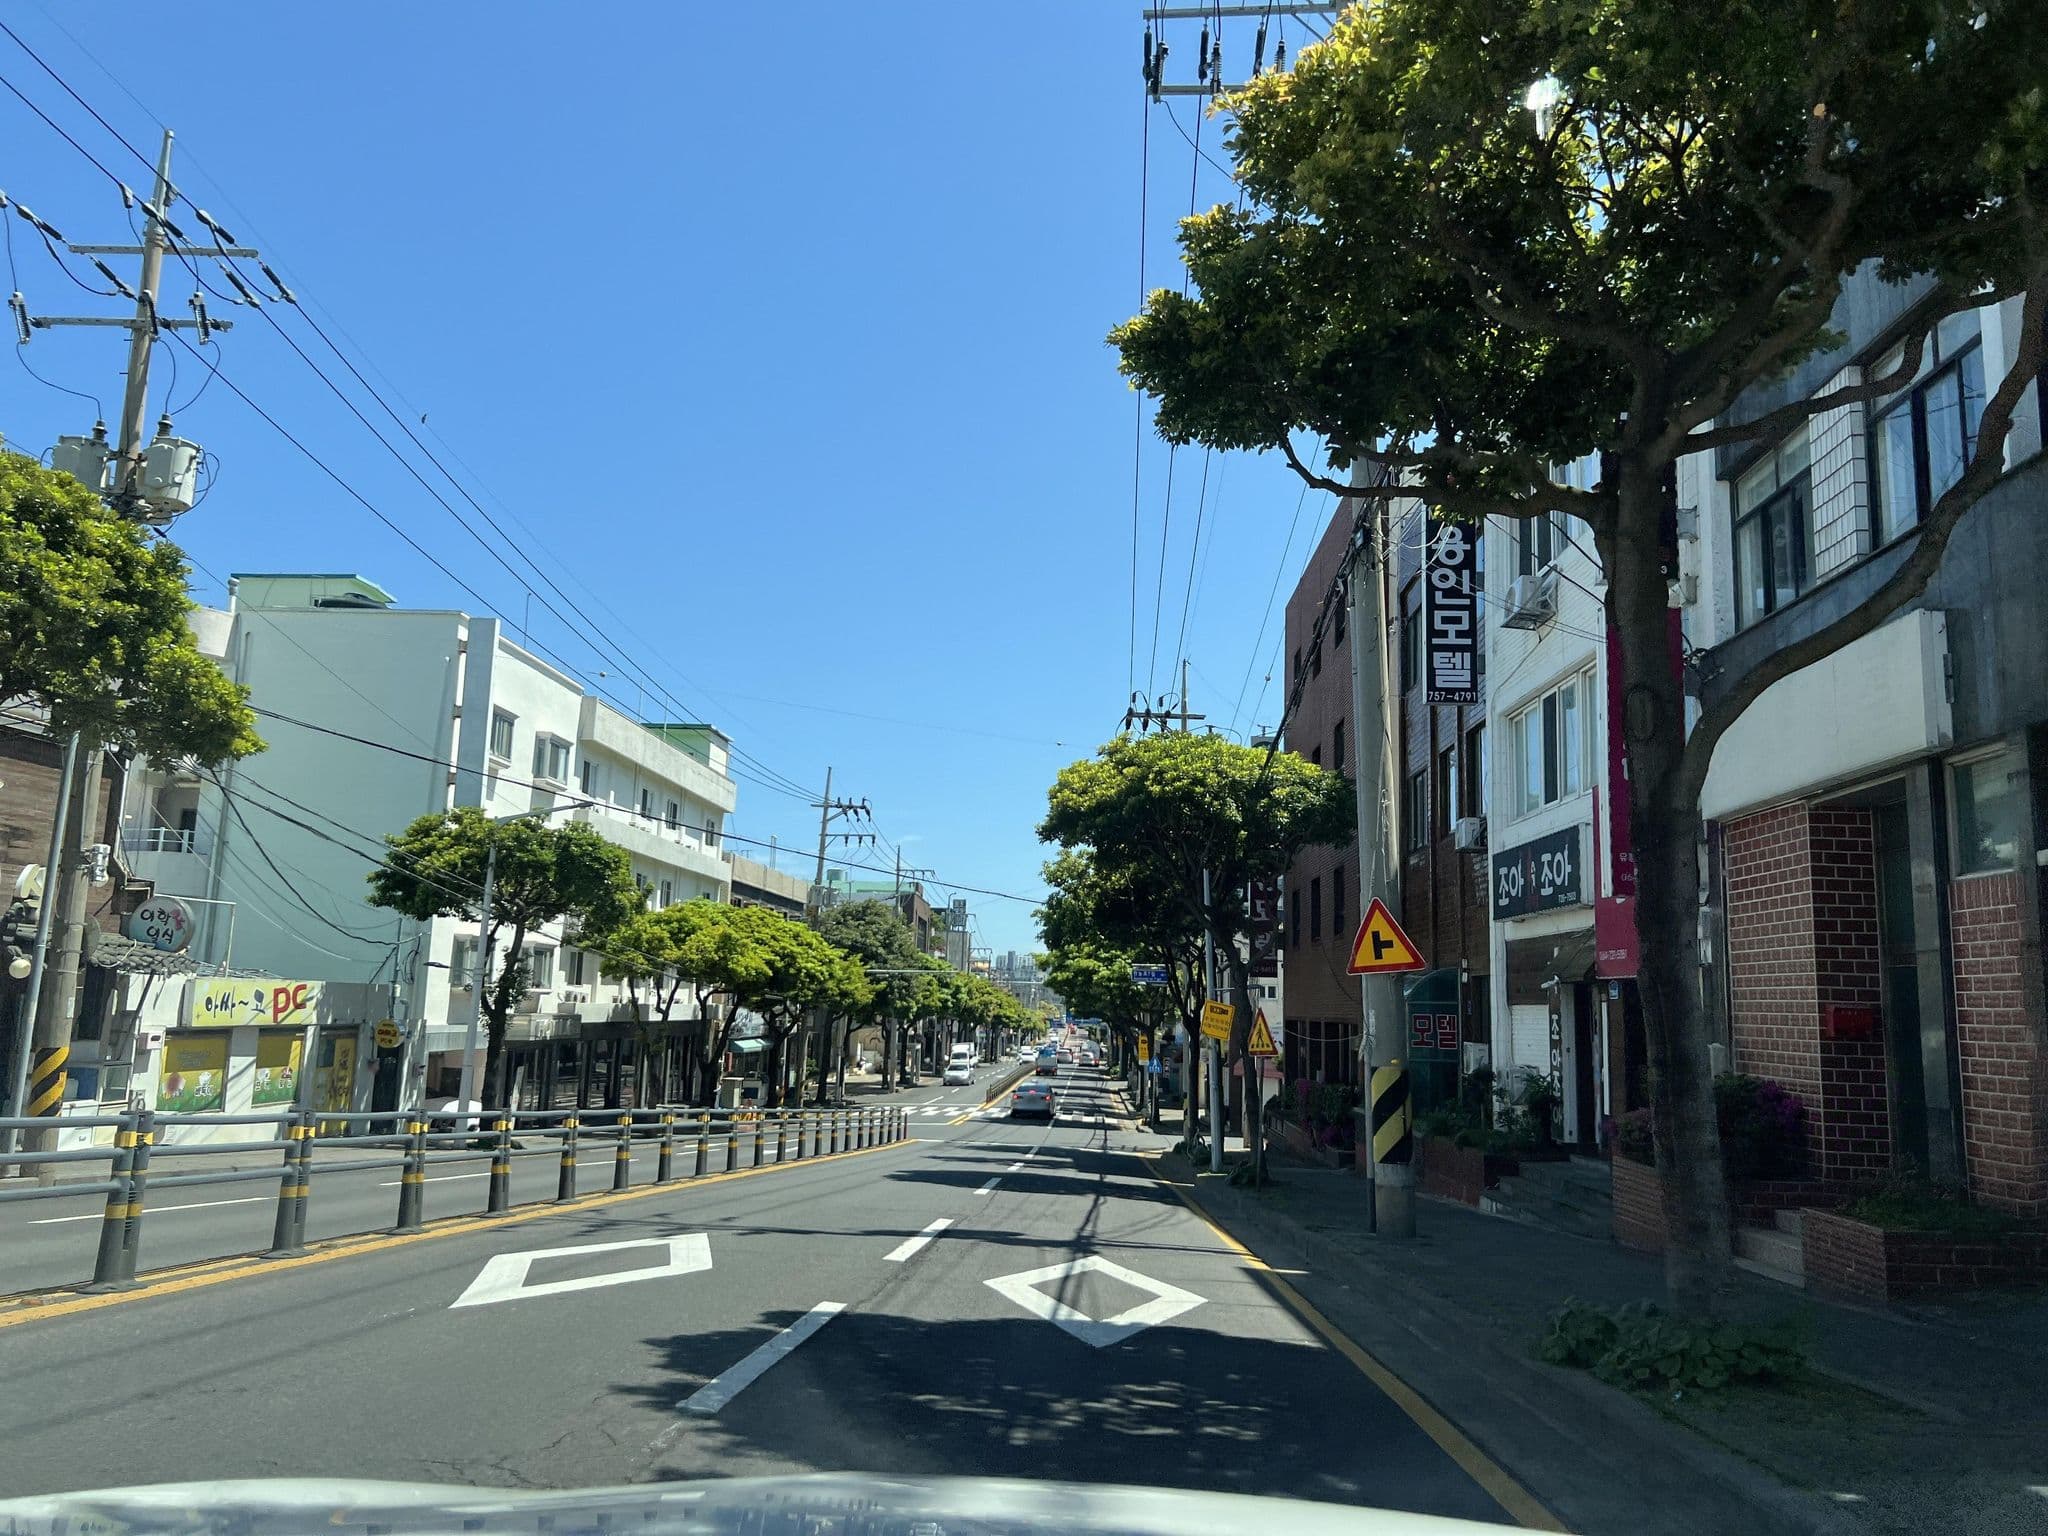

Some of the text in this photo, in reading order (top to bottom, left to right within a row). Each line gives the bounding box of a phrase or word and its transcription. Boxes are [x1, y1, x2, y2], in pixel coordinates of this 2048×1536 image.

[1431, 526, 1472, 689] 용인모텔
[1428, 690, 1477, 701] 757-4791
[1411, 1013, 1458, 1050] 모텔
